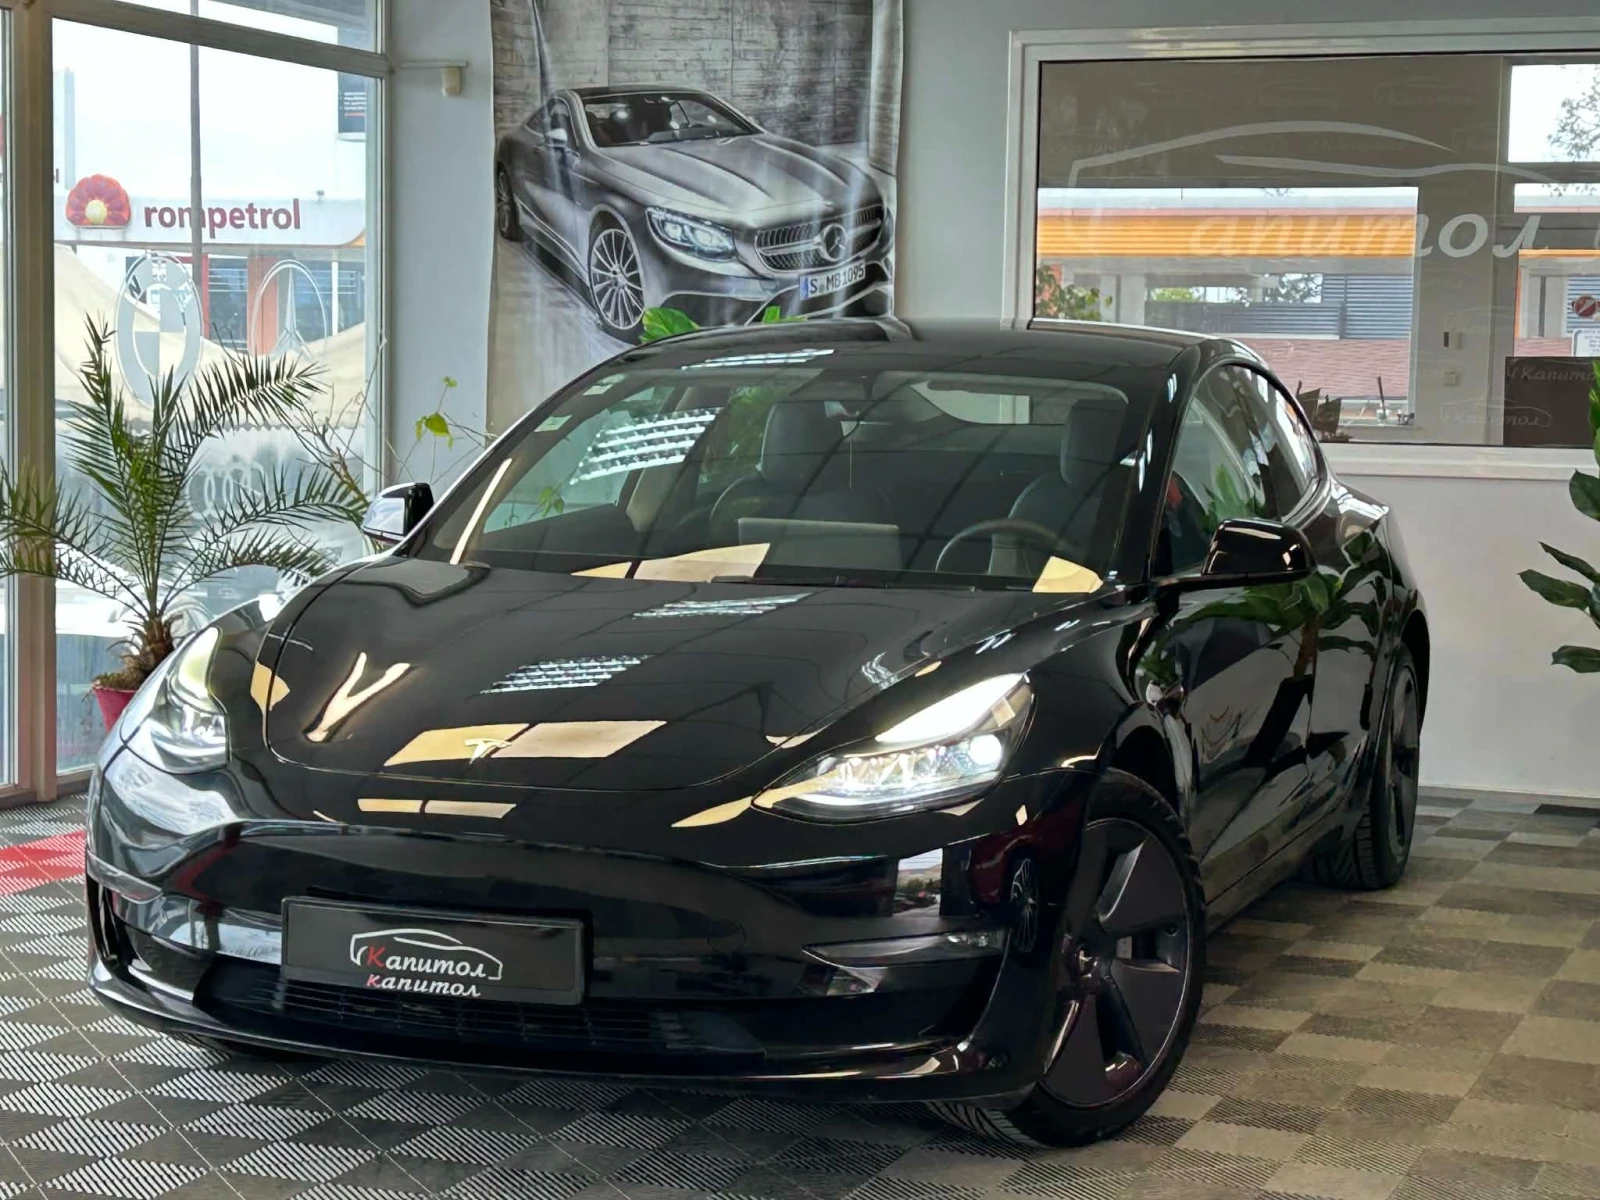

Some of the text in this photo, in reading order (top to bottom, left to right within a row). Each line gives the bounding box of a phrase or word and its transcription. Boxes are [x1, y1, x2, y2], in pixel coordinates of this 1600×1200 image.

[144, 198, 300, 239] rompetrol
[1188, 213, 1550, 258] апитол
[366, 945, 487, 978] Капитол
